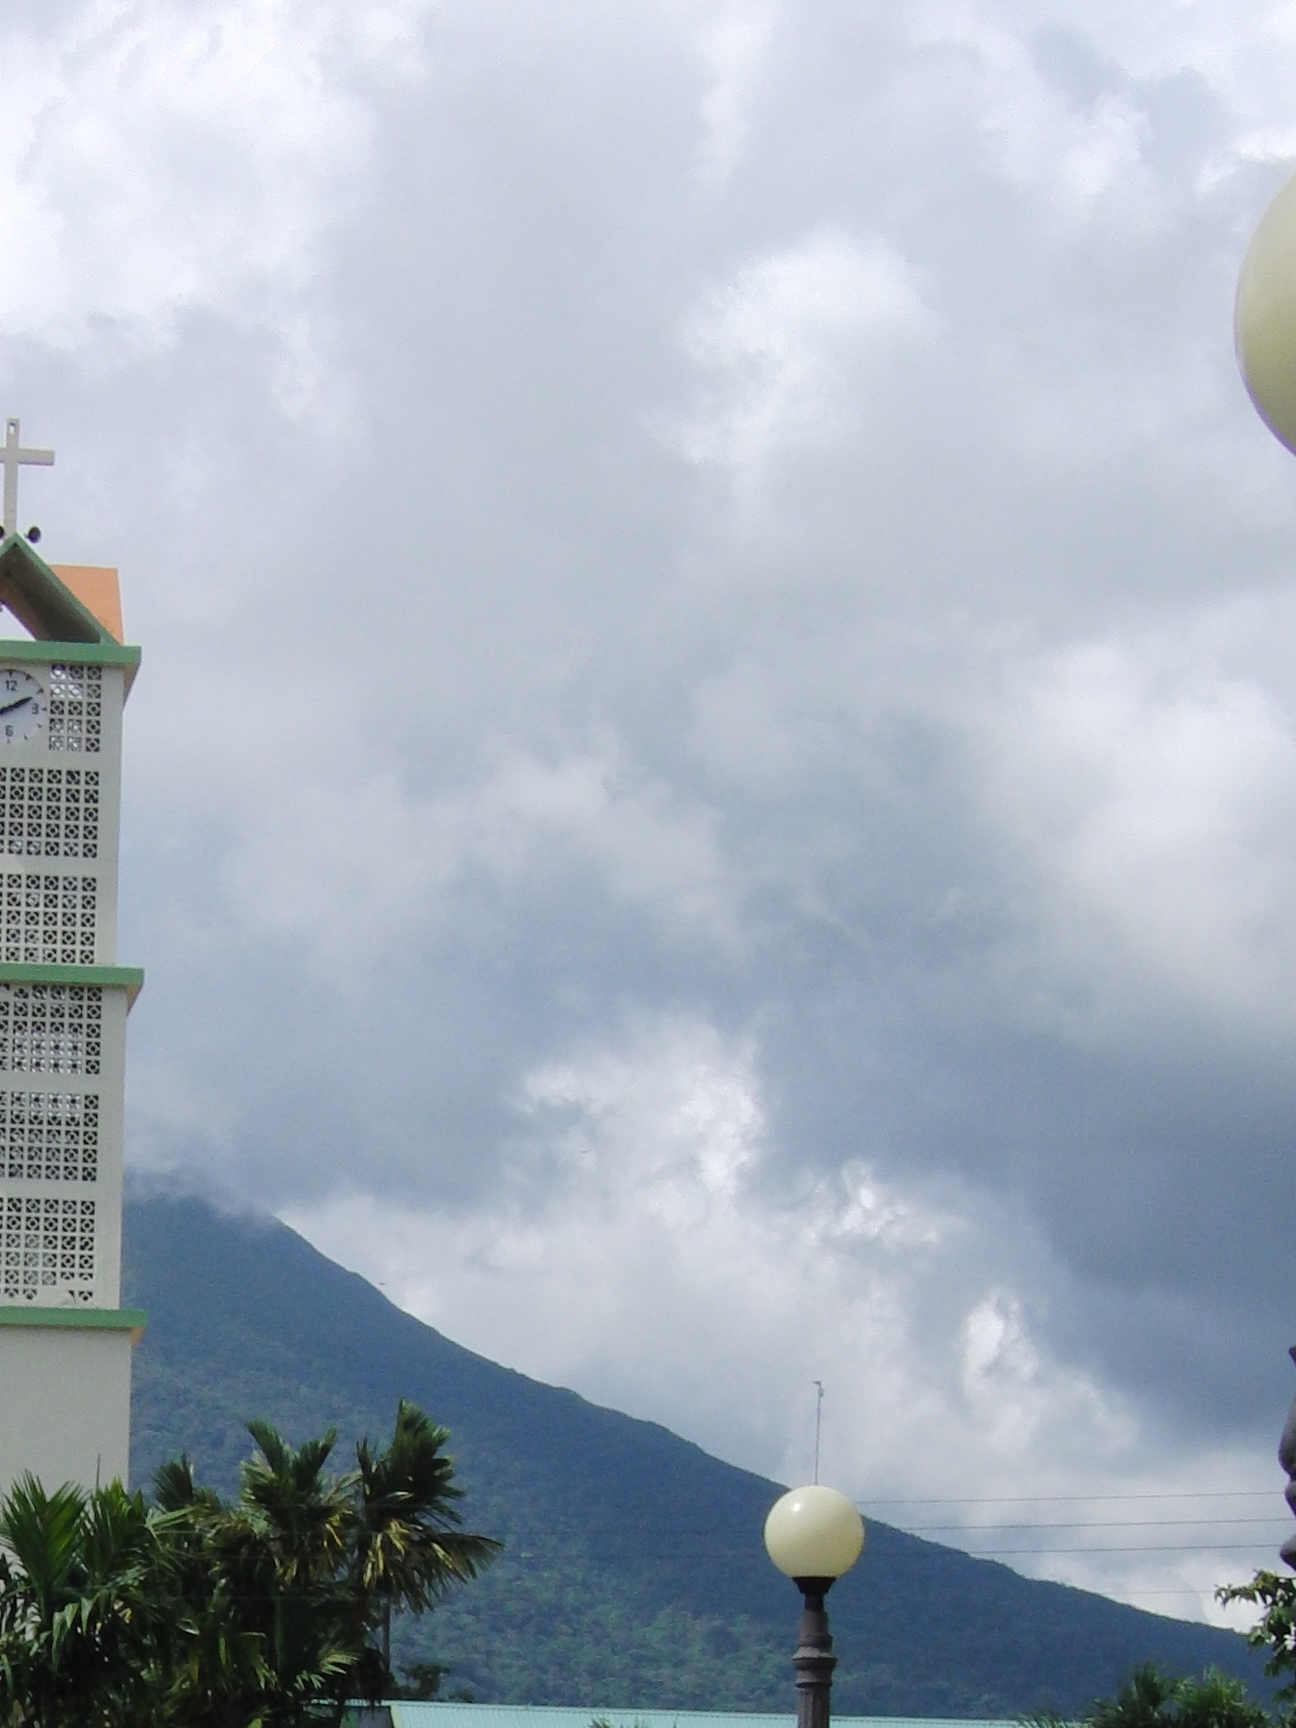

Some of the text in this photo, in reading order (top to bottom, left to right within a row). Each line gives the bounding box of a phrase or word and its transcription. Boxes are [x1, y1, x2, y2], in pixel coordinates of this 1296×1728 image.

[5, 680, 17, 691] 12
[31, 703, 39, 715] 3
[5, 725, 13, 737] 6
